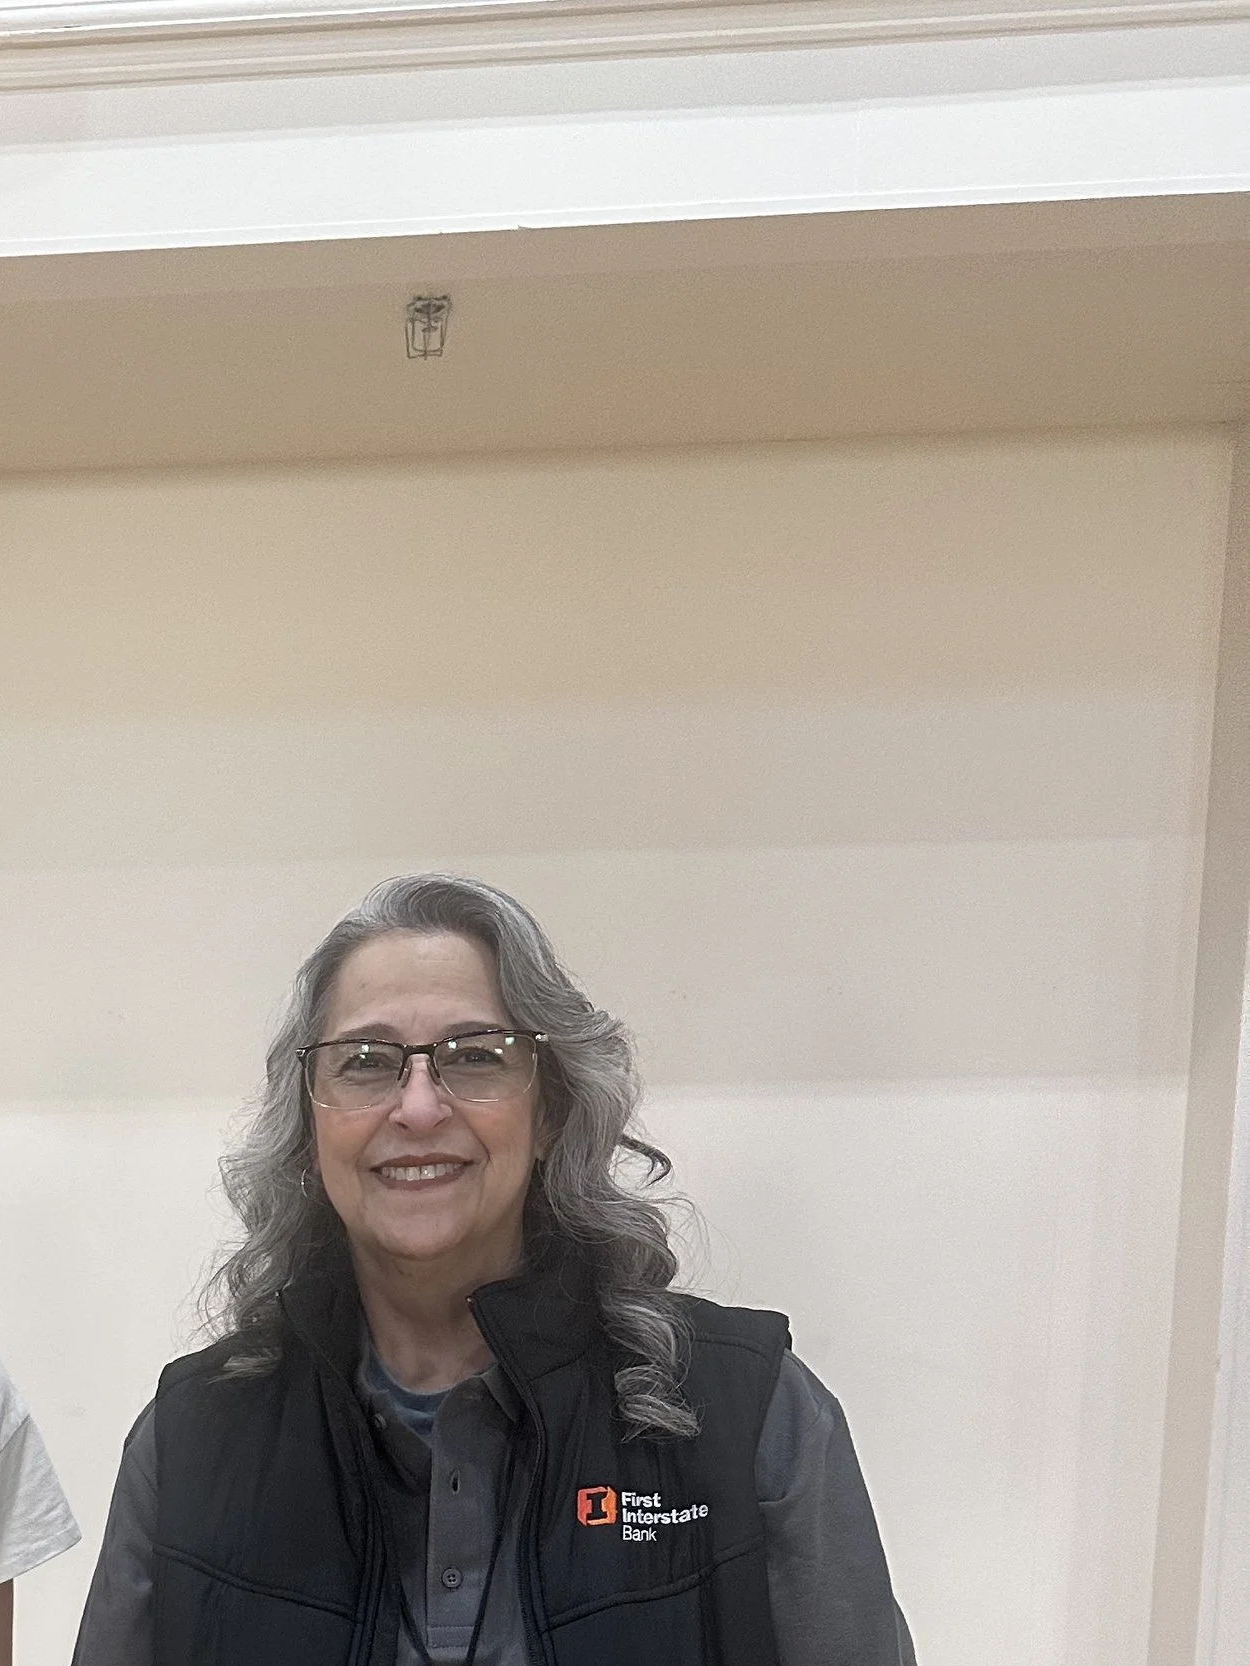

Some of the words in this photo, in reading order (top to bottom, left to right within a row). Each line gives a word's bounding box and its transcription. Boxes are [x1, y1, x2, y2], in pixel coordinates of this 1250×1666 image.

[621, 1491, 661, 1508] First
[622, 1504, 709, 1525] Interstate
[622, 1525, 657, 1542] Bank
